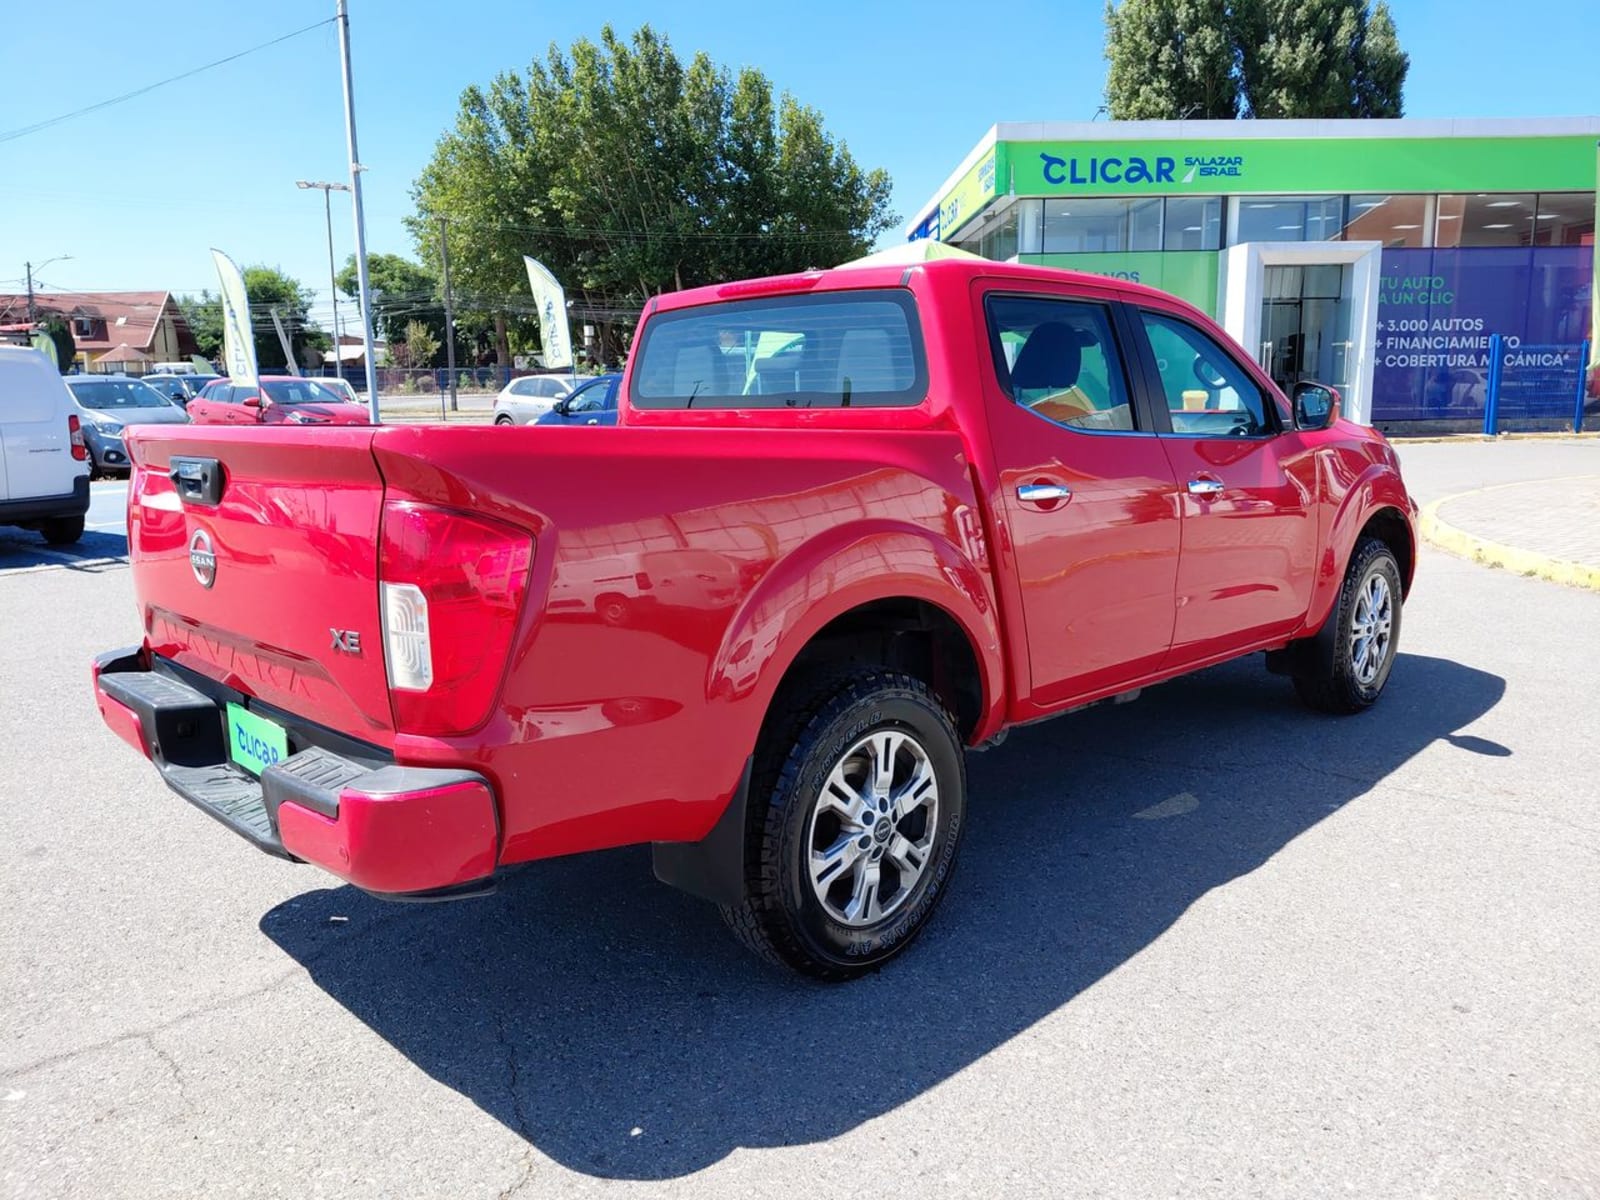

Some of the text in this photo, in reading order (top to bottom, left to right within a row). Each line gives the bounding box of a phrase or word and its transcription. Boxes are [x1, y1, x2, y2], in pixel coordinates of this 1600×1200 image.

[1184, 156, 1243, 166] SALAZAR
[1199, 166, 1242, 177] ISRAEL
[1380, 276, 1445, 290] TU AUTO
[1379, 291, 1455, 305] A UN CLIC
[1387, 319, 1429, 332] 3.000
[1431, 318, 1484, 332] AUTOS
[1385, 354, 1477, 368] COBERTURA
[329, 627, 361, 653] XE
